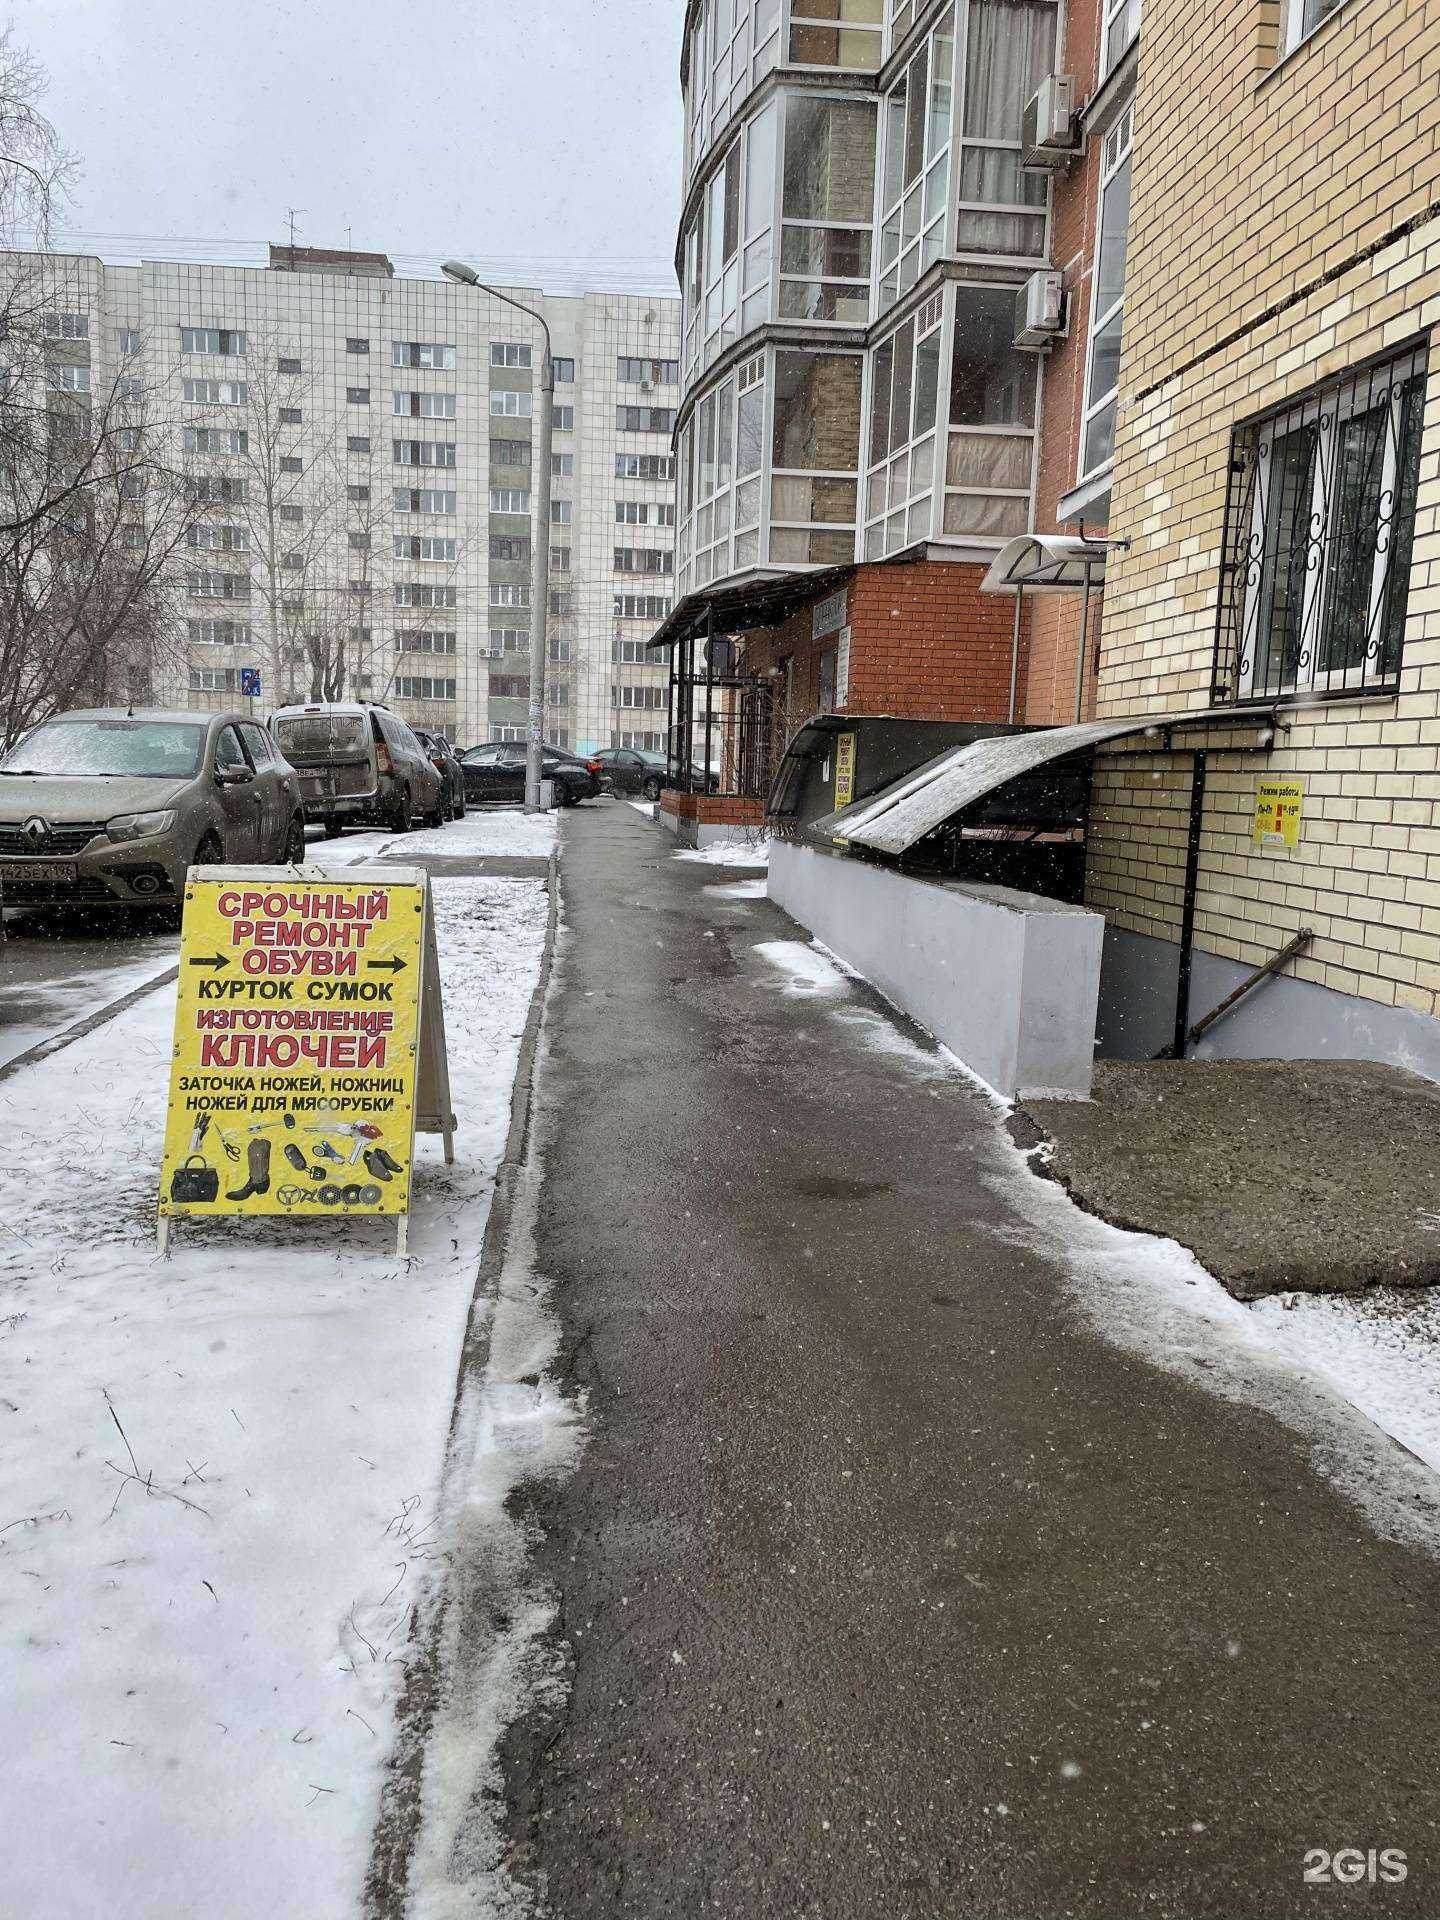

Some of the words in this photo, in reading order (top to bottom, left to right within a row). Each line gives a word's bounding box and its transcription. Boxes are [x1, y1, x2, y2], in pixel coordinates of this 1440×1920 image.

[218, 890, 389, 920] СРОЧНЫЙ
[232, 921, 372, 947] РЕМОНТ
[242, 949, 357, 975] ОБУВИ
[198, 980, 293, 1000] КУРТОК
[307, 982, 393, 1001] СУМОК
[196, 1009, 393, 1031] ИЗГОТОВЛЕНИЕ
[200, 1030, 387, 1068] КЛЮЧЕЙ
[178, 1076, 255, 1092] ЗАТОЧКА
[260, 1075, 326, 1093] НОЖЕЙ,
[331, 1078, 404, 1094] НОЖНИЦ
[186, 1093, 247, 1111] НОЖЕЙ
[251, 1097, 286, 1112] ДЛЯ
[292, 1096, 394, 1111] МЯСОРУБКИ
